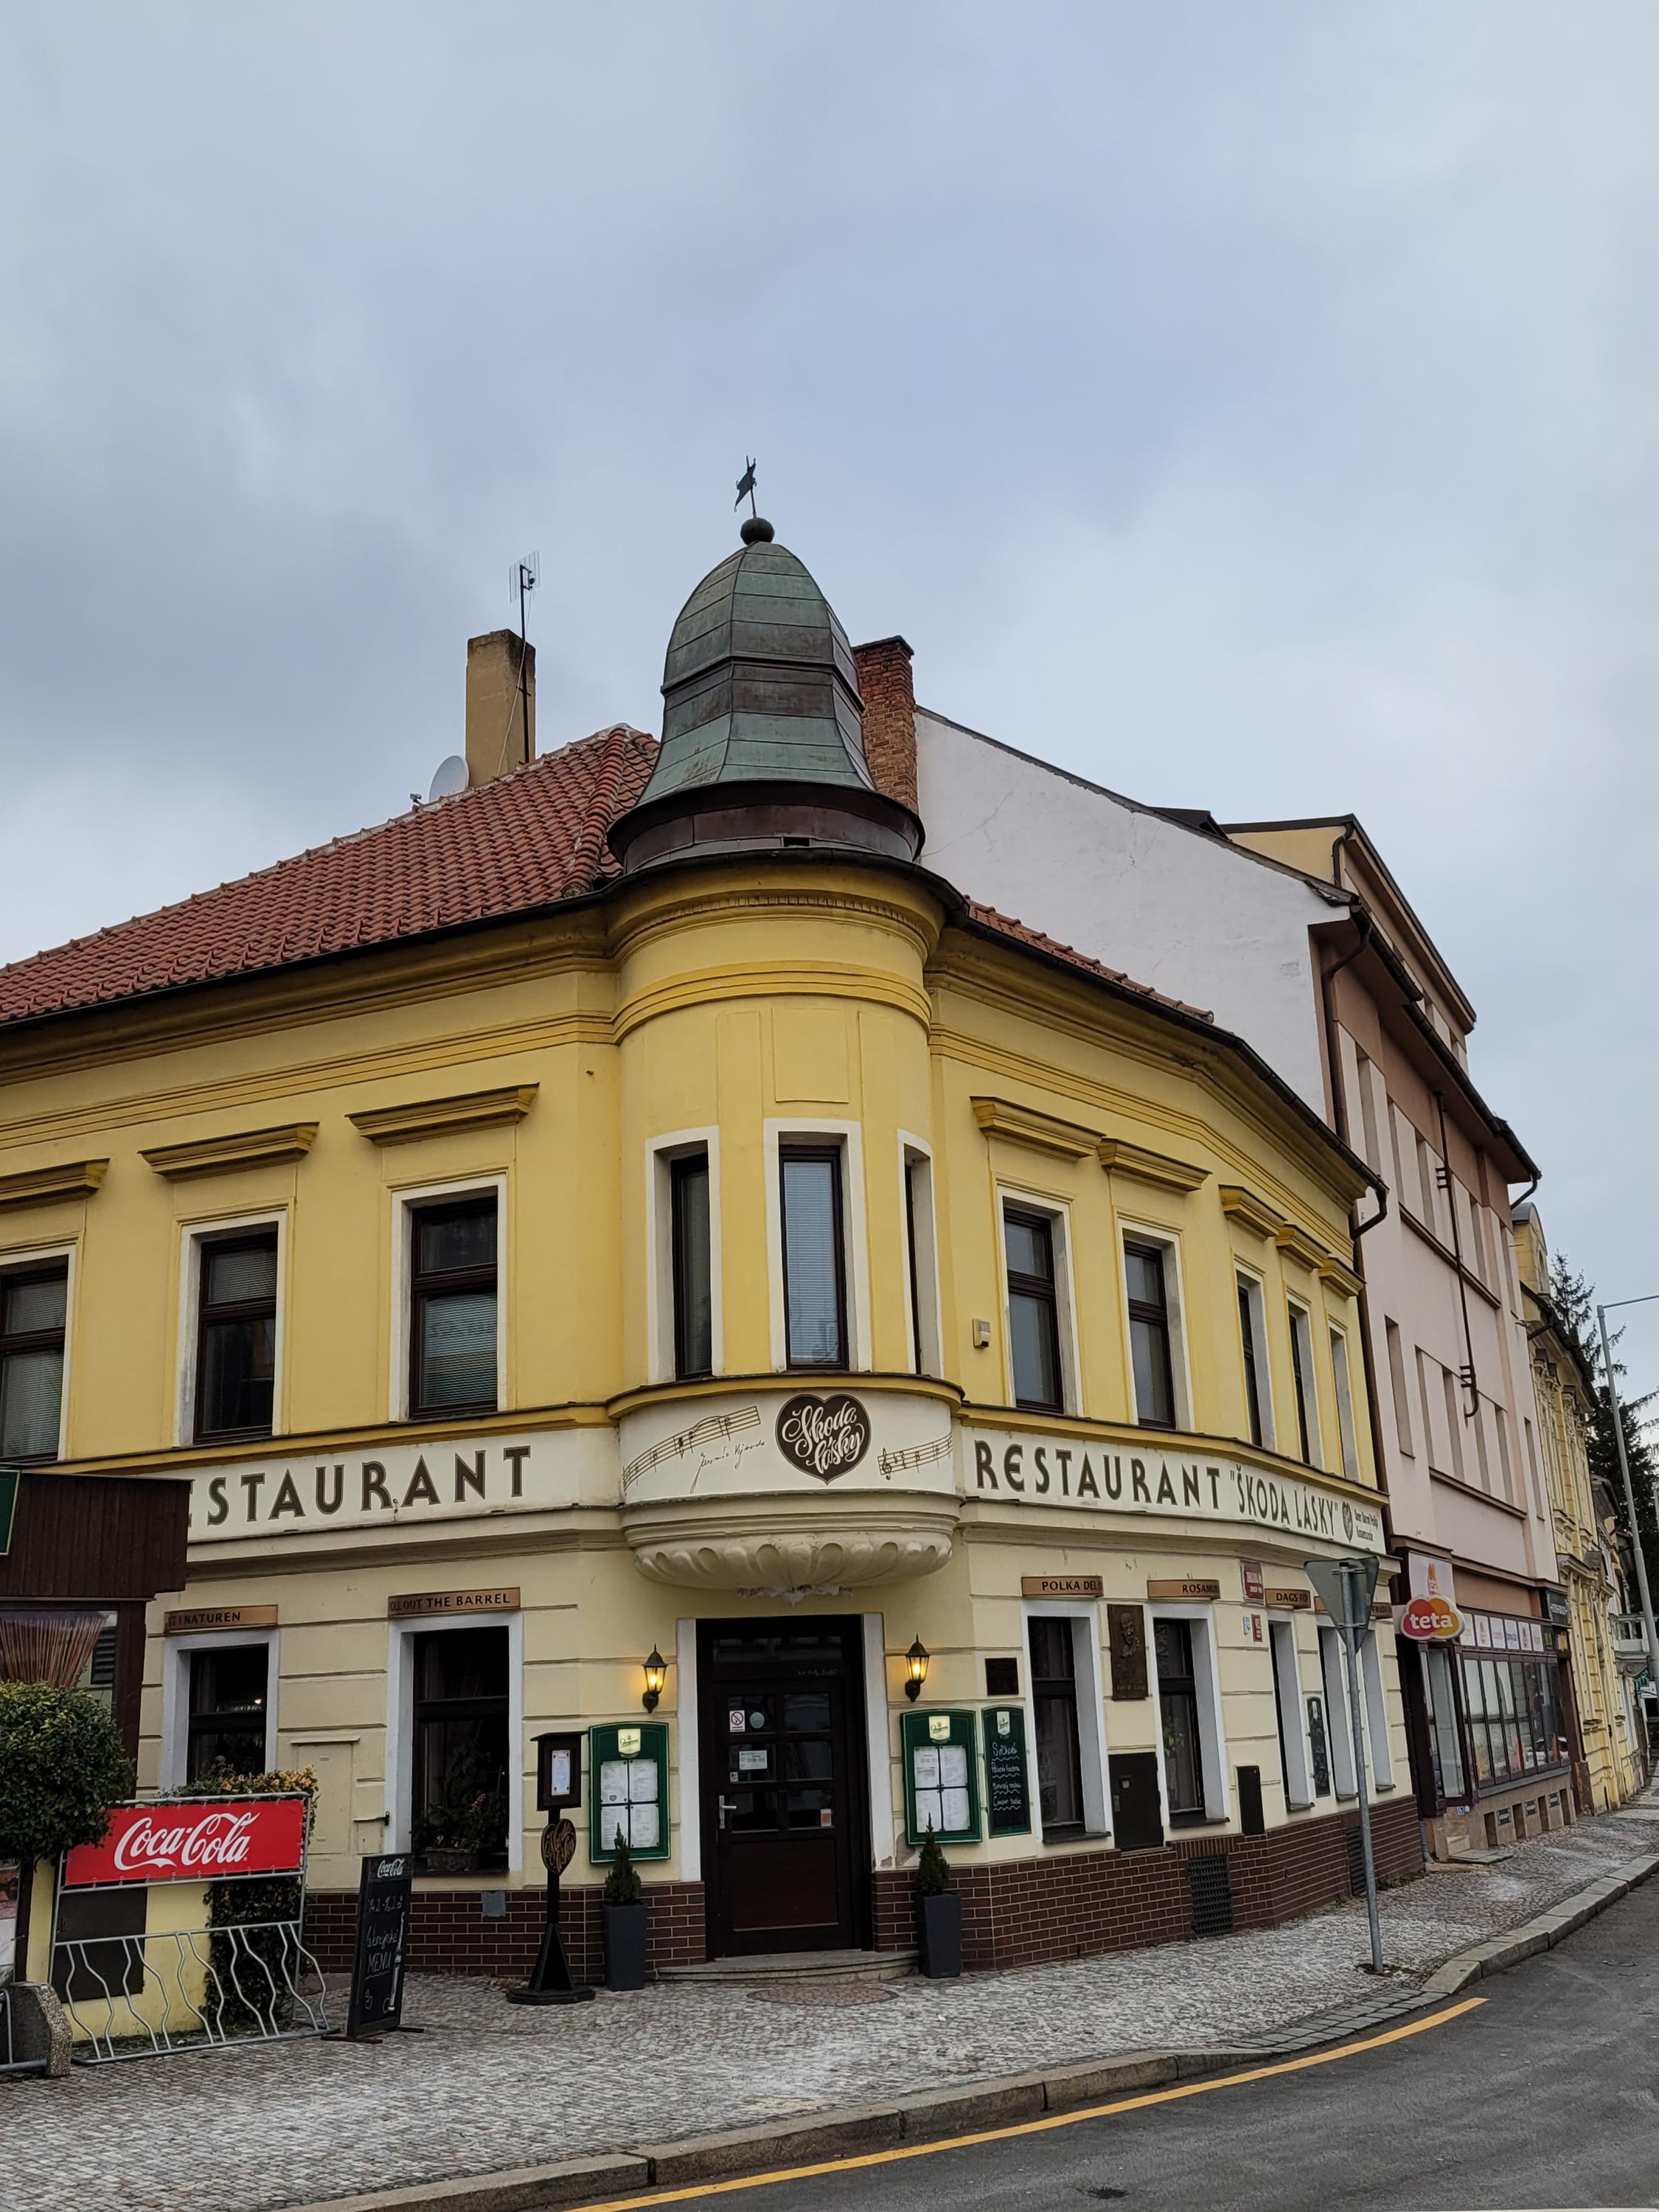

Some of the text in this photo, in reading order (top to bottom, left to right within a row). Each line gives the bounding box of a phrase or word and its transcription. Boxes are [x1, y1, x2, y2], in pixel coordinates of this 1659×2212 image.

[782, 1401, 858, 1458] Škoda
[974, 1439, 1220, 1509] RESTAURANT
[189, 1444, 532, 1527] STAURANT
[1041, 1580, 1081, 1591] POLKA
[403, 1598, 423, 1610] OUT
[425, 1596, 451, 1608] THE
[456, 1593, 510, 1606] BARREL
[1276, 1592, 1298, 1602] DAGS
[184, 1611, 241, 1625] NATUREN
[1409, 1612, 1453, 1630] teta
[114, 1812, 261, 1871] Coca-Cola
[377, 1858, 405, 1878] Coca-Cola
[367, 1952, 391, 1974] MENU
